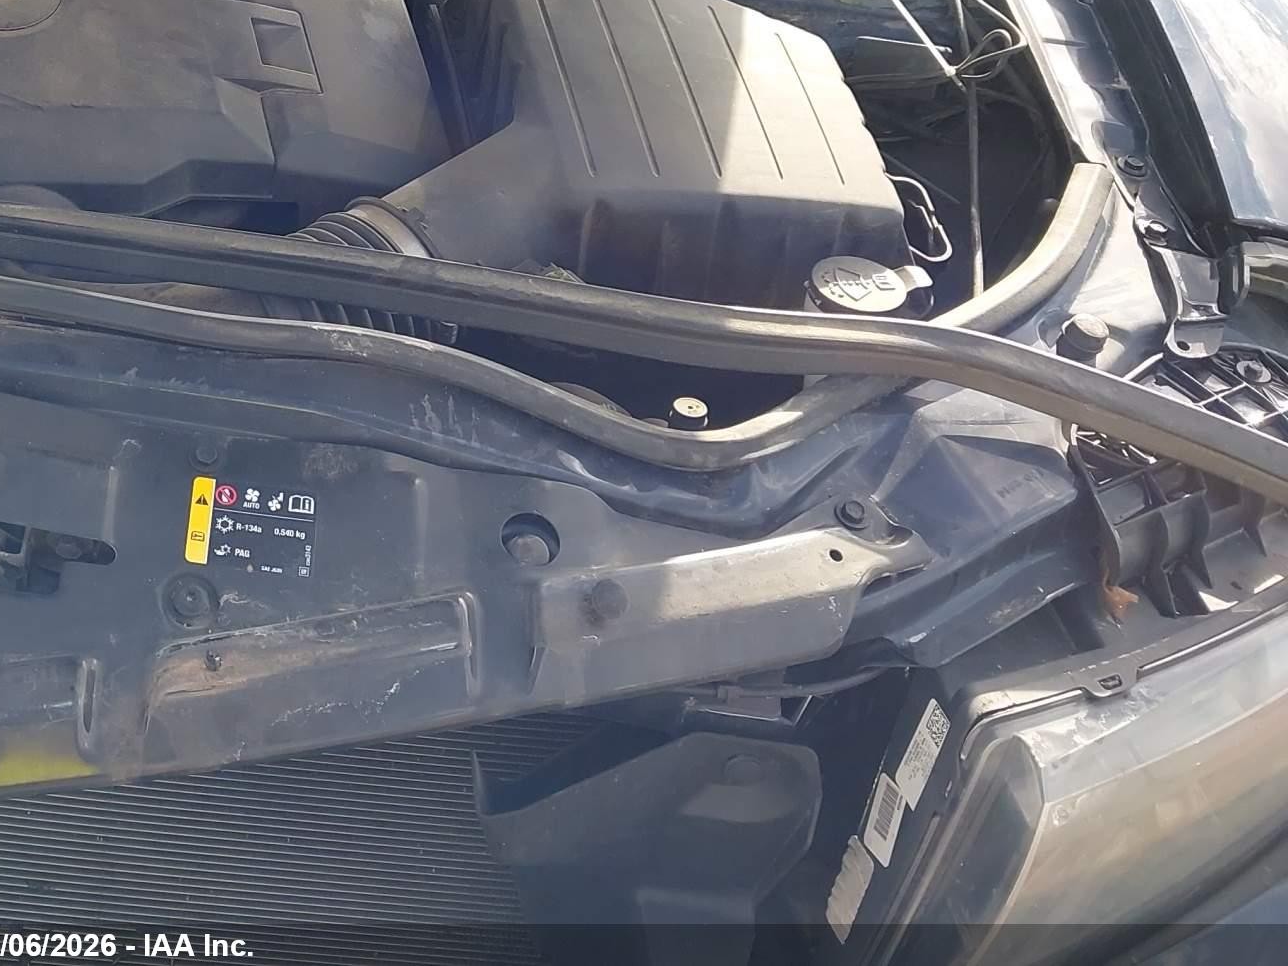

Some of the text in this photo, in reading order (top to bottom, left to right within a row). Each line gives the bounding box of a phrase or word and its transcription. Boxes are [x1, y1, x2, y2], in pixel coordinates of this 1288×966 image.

[243, 501, 260, 510] AUTO
[236, 523, 262, 533] R-134a
[295, 530, 306, 540] kg
[234, 548, 250, 558] PAG
